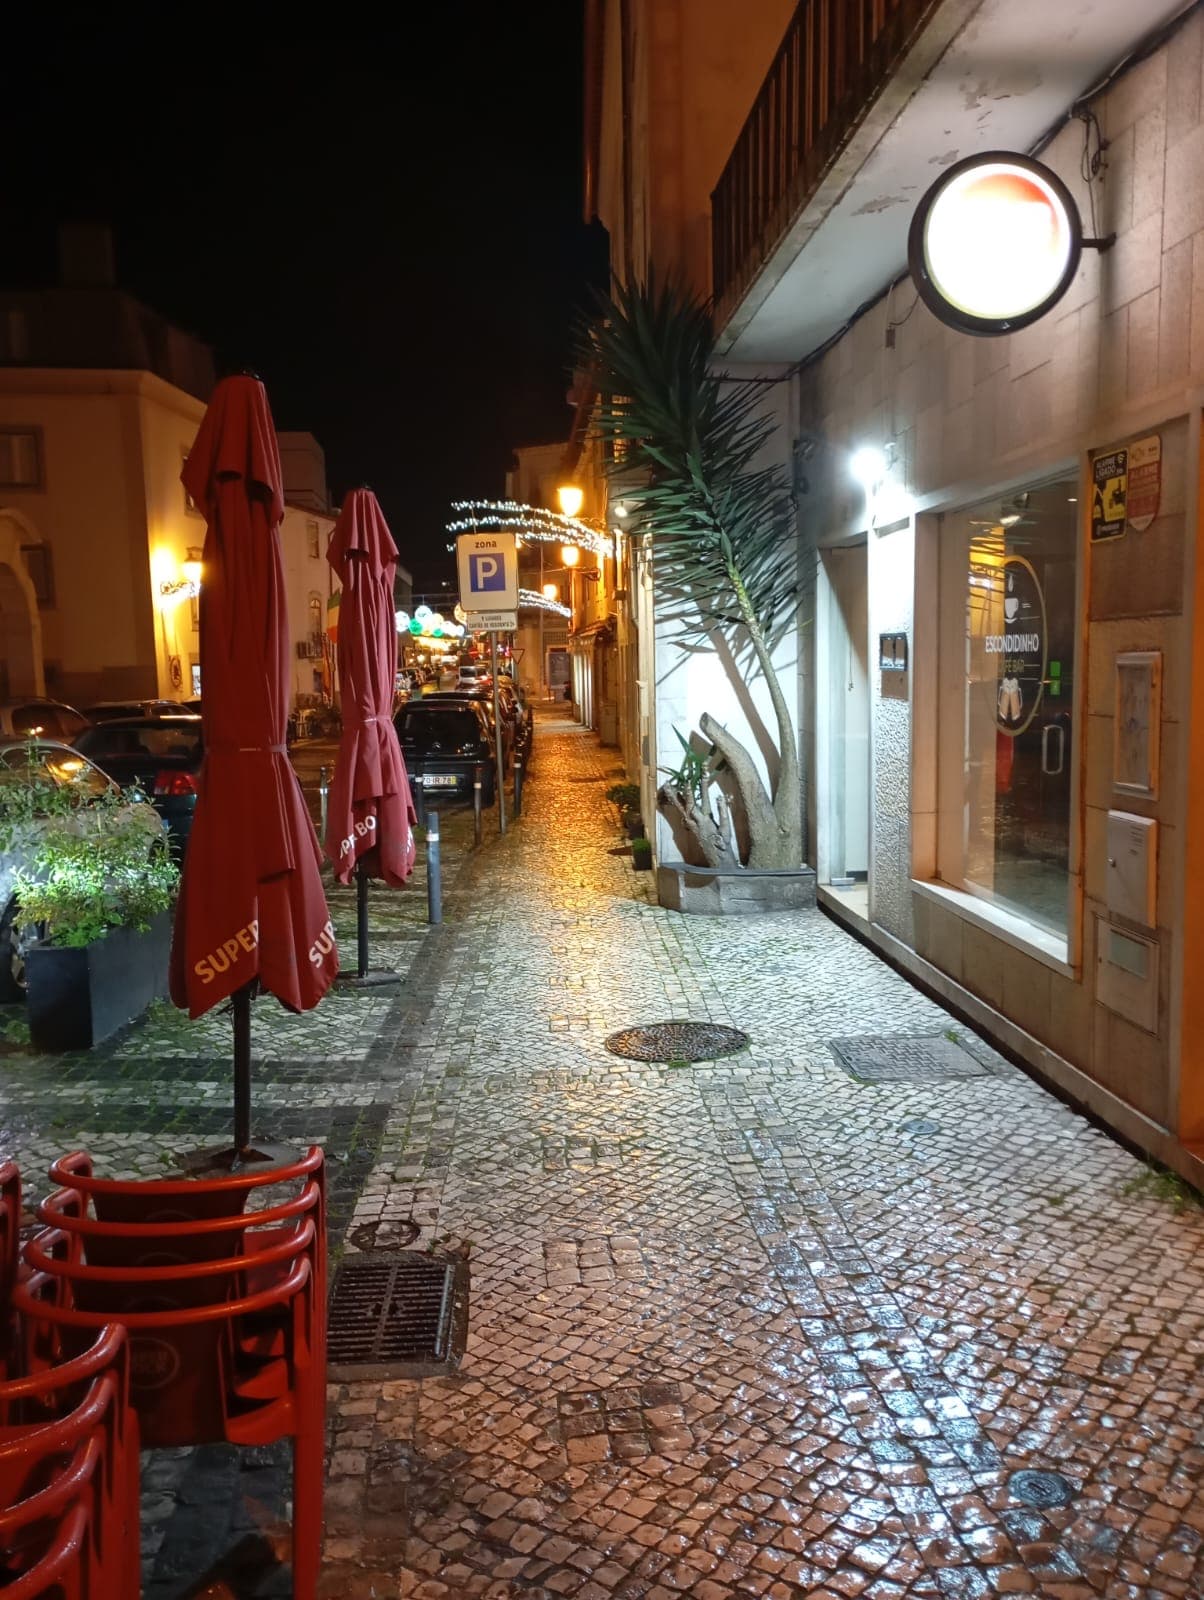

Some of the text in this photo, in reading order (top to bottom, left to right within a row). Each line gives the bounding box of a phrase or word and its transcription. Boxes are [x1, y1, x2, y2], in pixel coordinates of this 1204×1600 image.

[474, 540, 497, 549] zona
[476, 556, 498, 590] P
[985, 634, 1039, 653] ESCONDIDINHO
